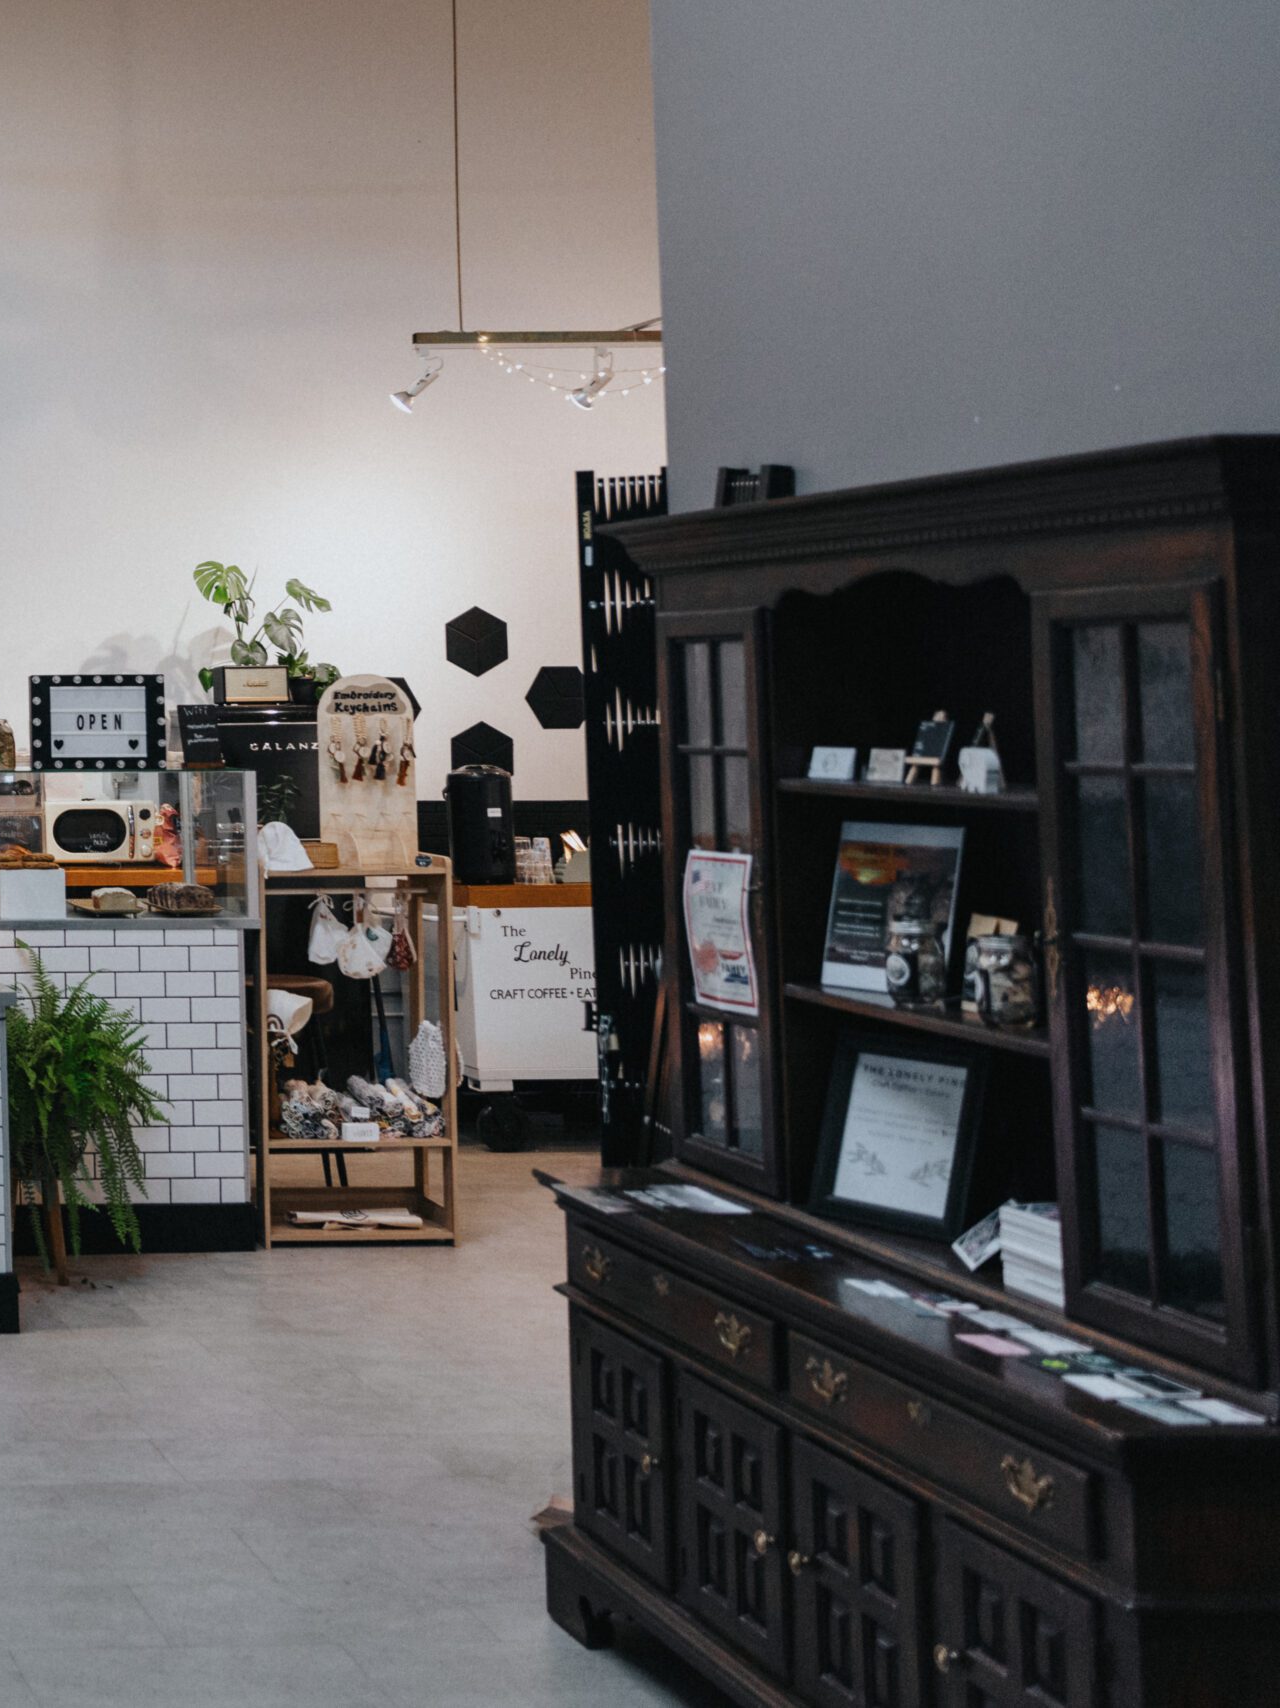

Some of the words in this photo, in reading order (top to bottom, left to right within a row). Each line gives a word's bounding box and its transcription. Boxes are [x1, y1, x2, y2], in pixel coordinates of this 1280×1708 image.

[334, 702, 398, 715] Keychains
[76, 714, 122, 731] OPEN
[250, 742, 320, 751] GALANZ
[501, 925, 526, 937] The
[514, 941, 571, 966] Lonely
[490, 989, 525, 999] CRAFT
[527, 988, 567, 998] COFFEE
